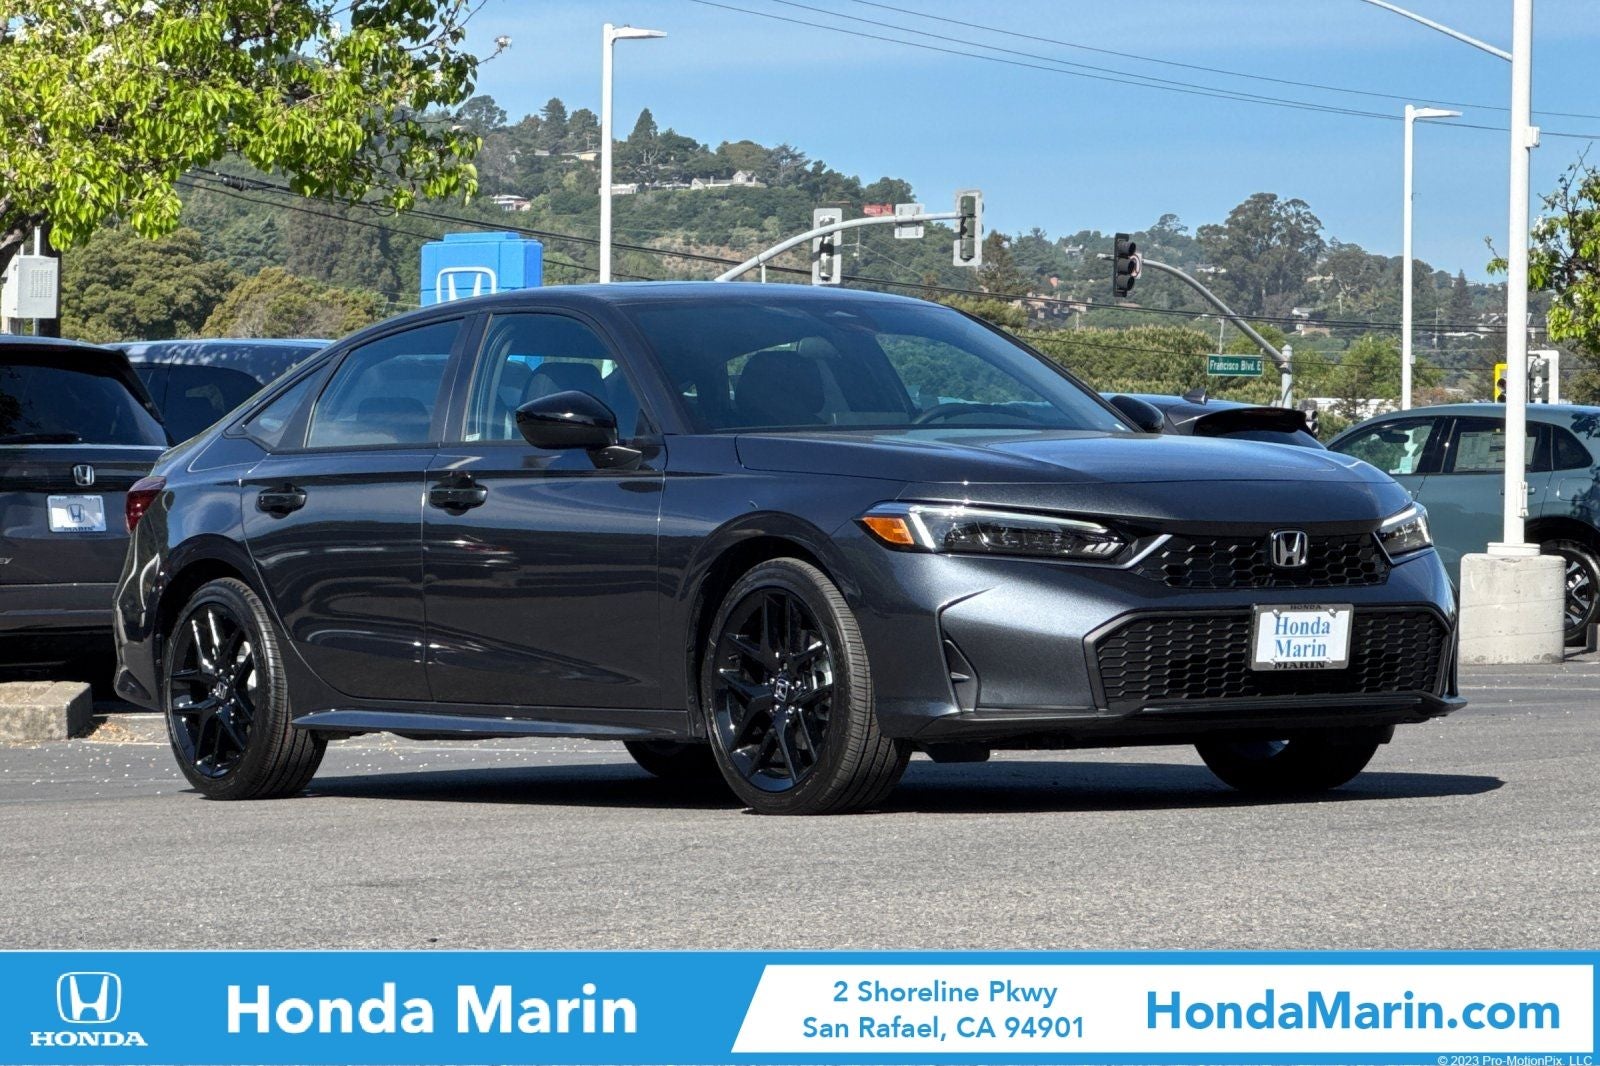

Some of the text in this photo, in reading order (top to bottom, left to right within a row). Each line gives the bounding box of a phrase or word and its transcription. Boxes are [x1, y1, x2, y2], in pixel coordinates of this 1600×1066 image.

[1209, 359, 1239, 371] Francisco
[1256, 360, 1262, 371] E
[1274, 616, 1331, 635] Honda
[1274, 638, 1327, 658] Marin
[1274, 661, 1325, 669] MARIN
